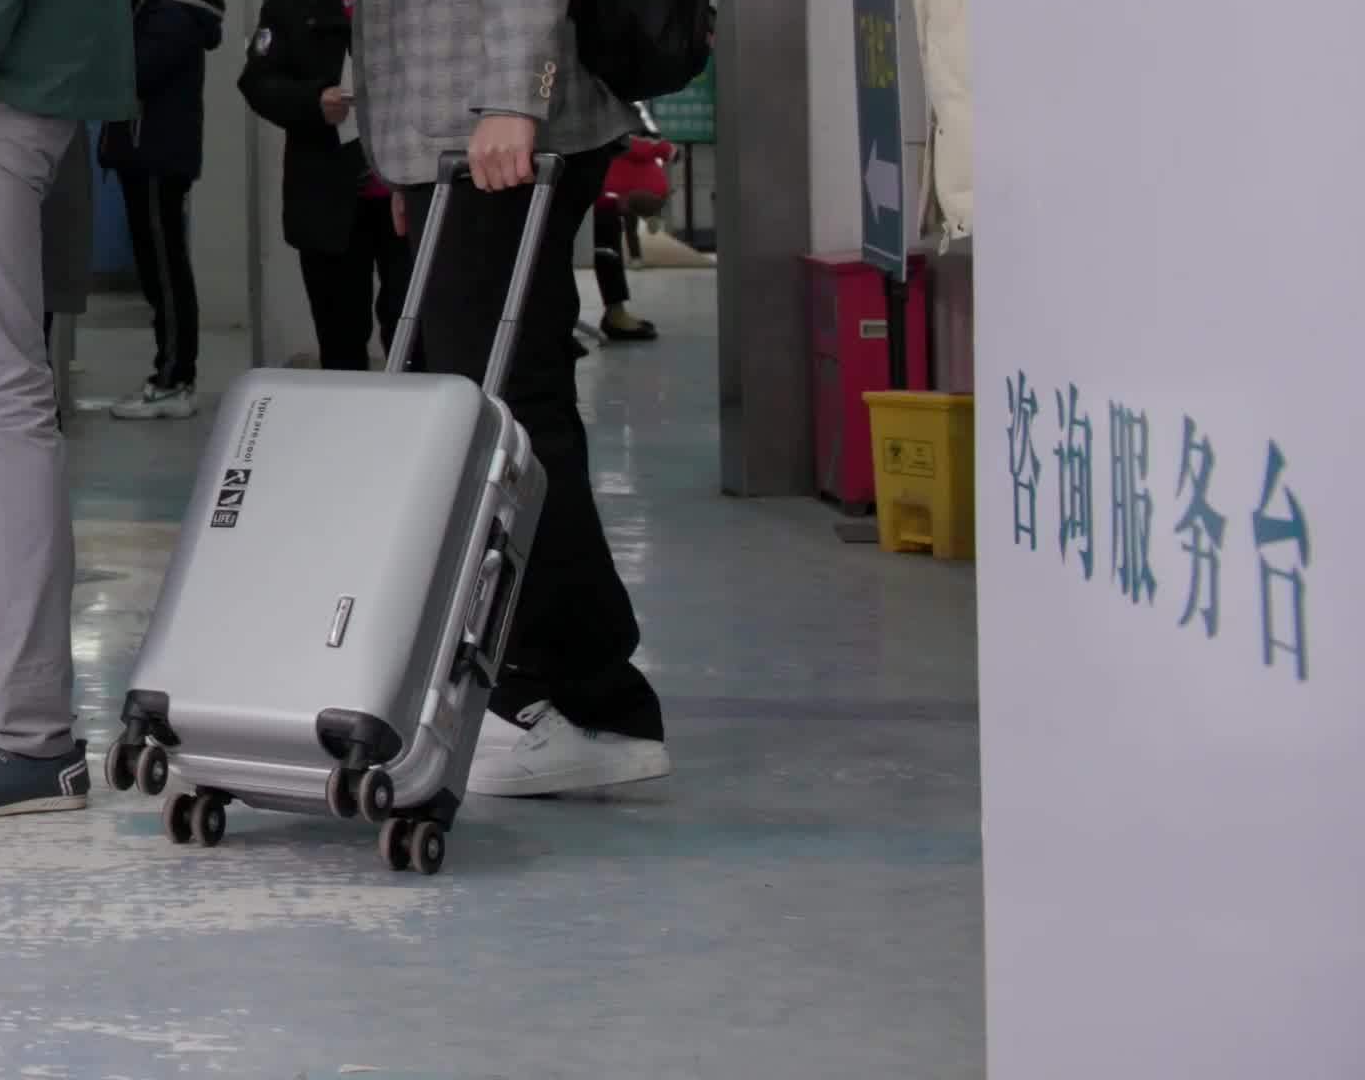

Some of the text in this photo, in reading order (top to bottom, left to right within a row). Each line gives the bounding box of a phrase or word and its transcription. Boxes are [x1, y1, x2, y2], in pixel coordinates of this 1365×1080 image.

[1006, 369, 1310, 682] 咨询服务台
